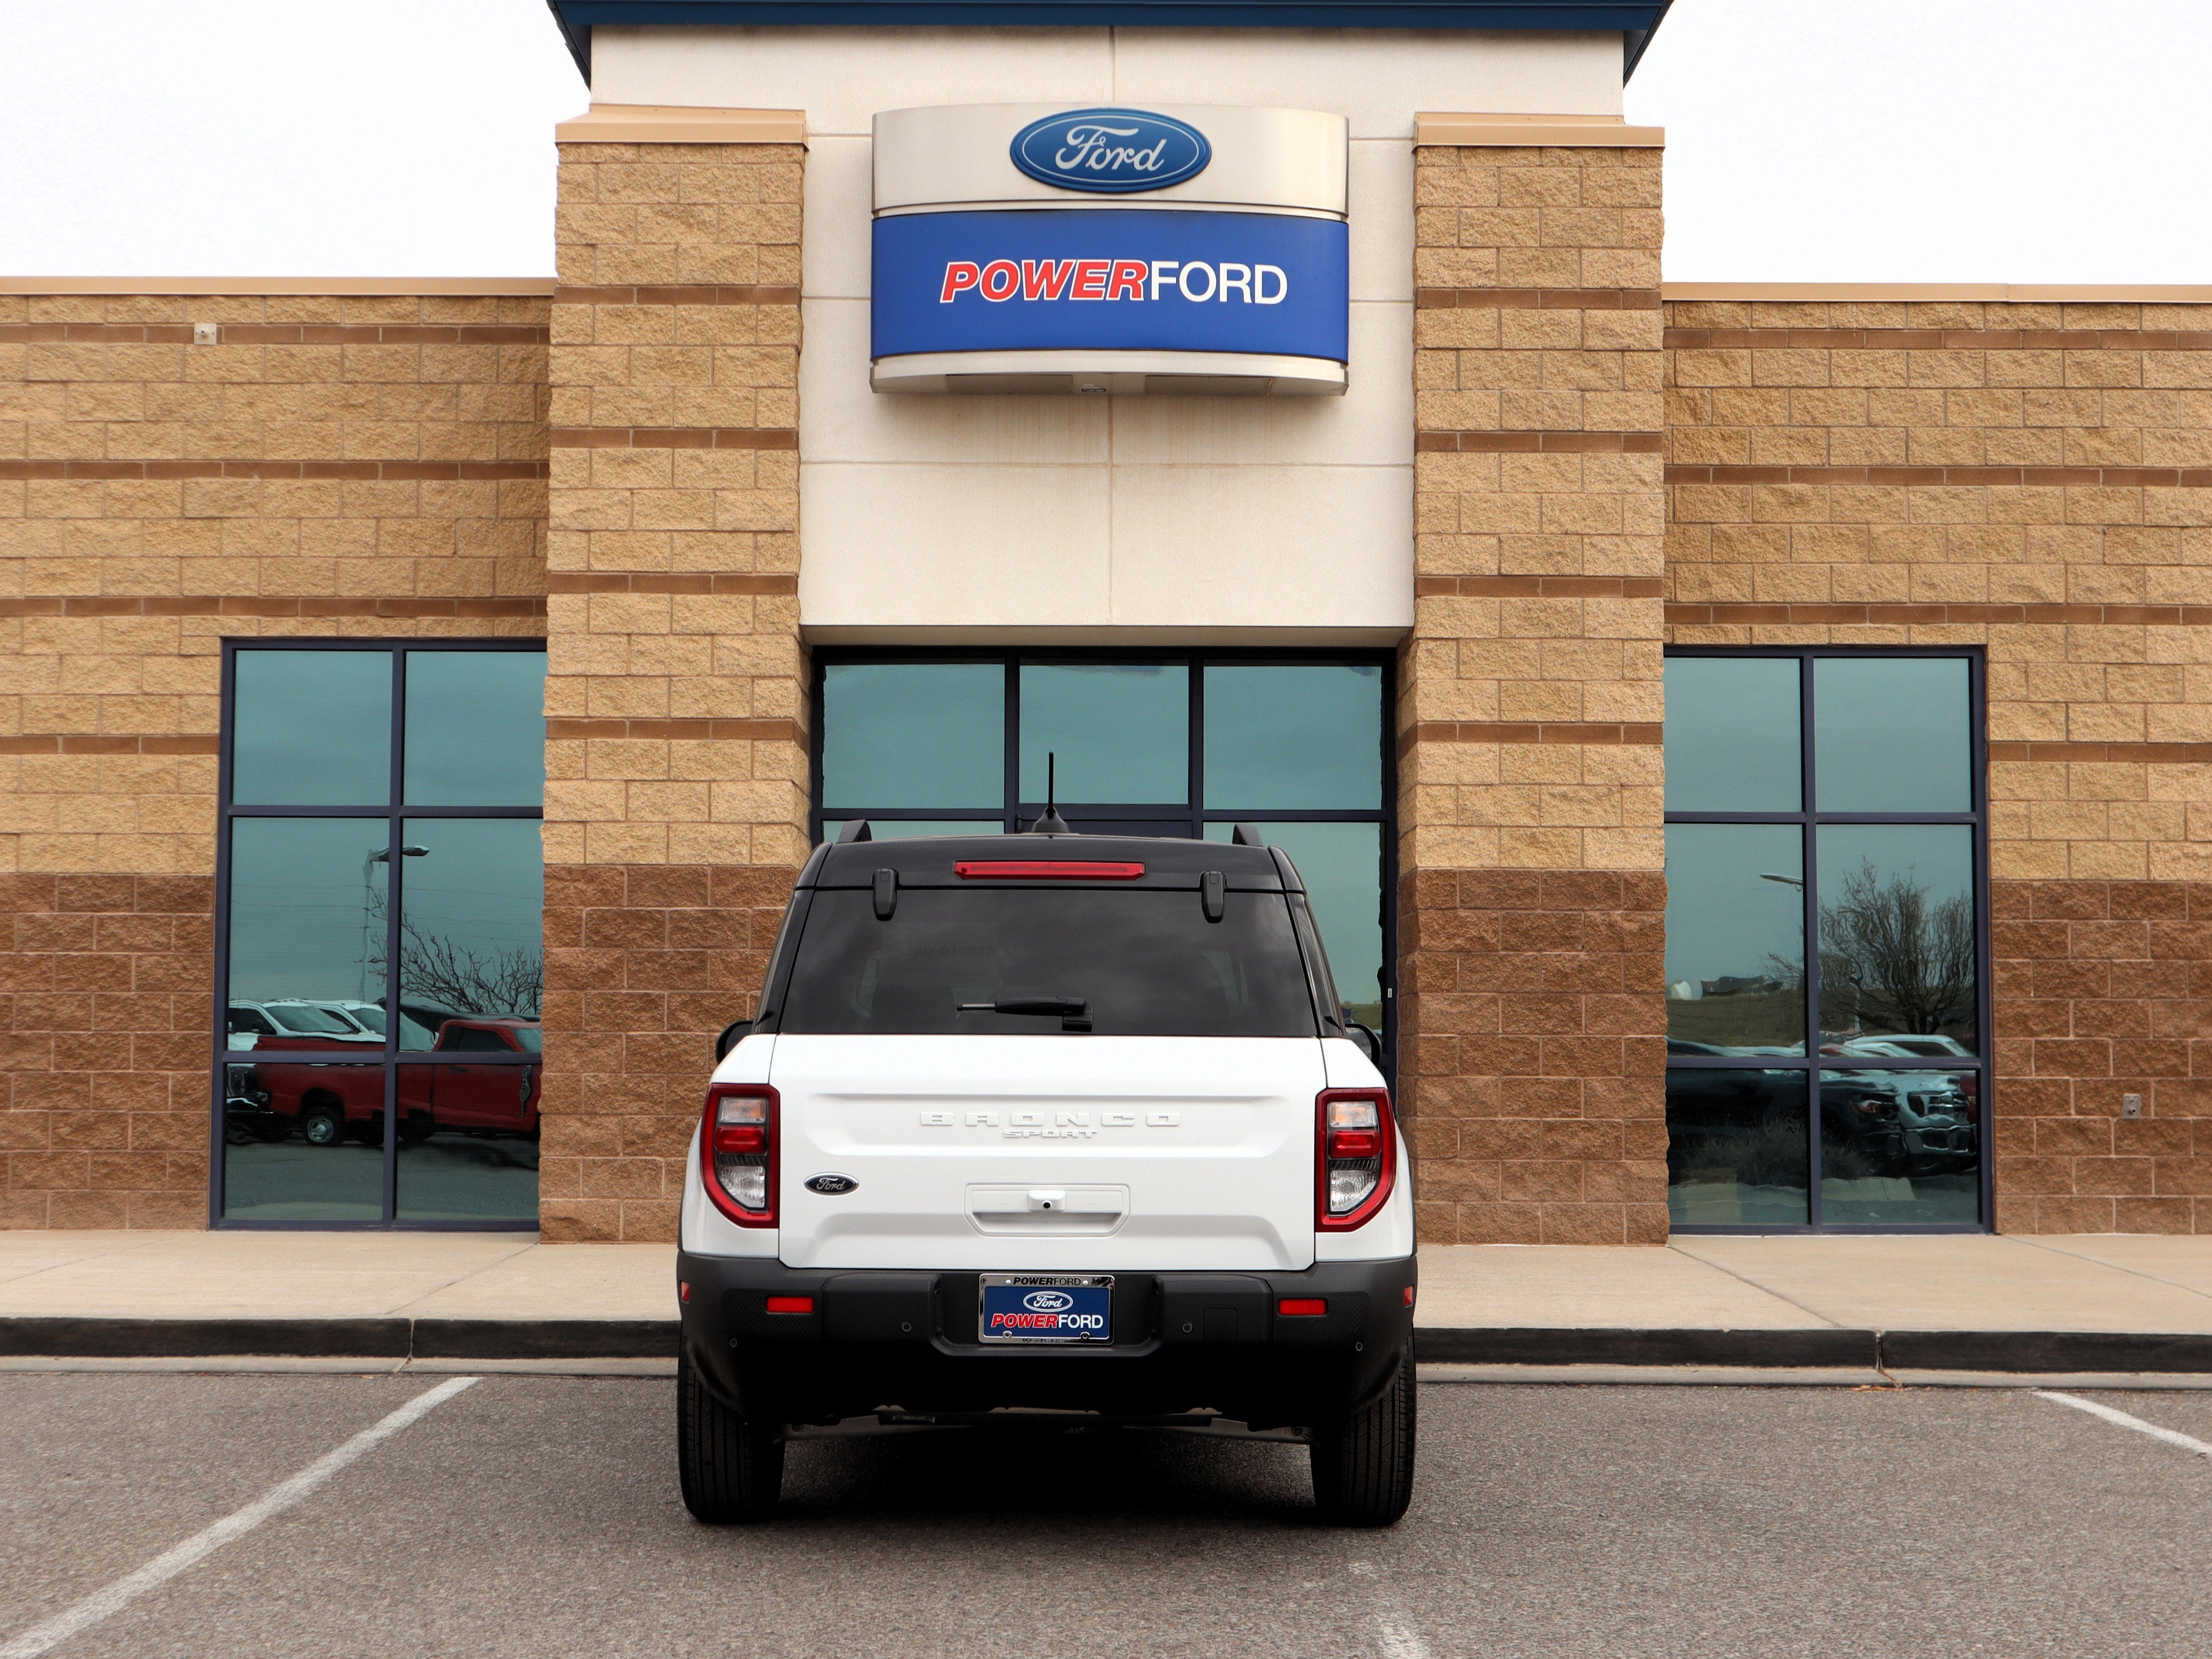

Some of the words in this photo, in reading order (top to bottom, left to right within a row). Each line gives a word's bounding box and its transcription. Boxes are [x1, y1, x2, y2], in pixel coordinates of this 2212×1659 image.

[1055, 125, 1165, 172] Ford
[939, 259, 1288, 305] POWERFORD
[920, 1111, 1180, 1127] BRONCO
[1003, 1130, 1097, 1139] SPORT
[815, 1177, 846, 1190] Ford
[1013, 1277, 1081, 1286] POWERFORD
[1033, 1295, 1063, 1308] Ford
[991, 1313, 1104, 1329] POWERFORD
